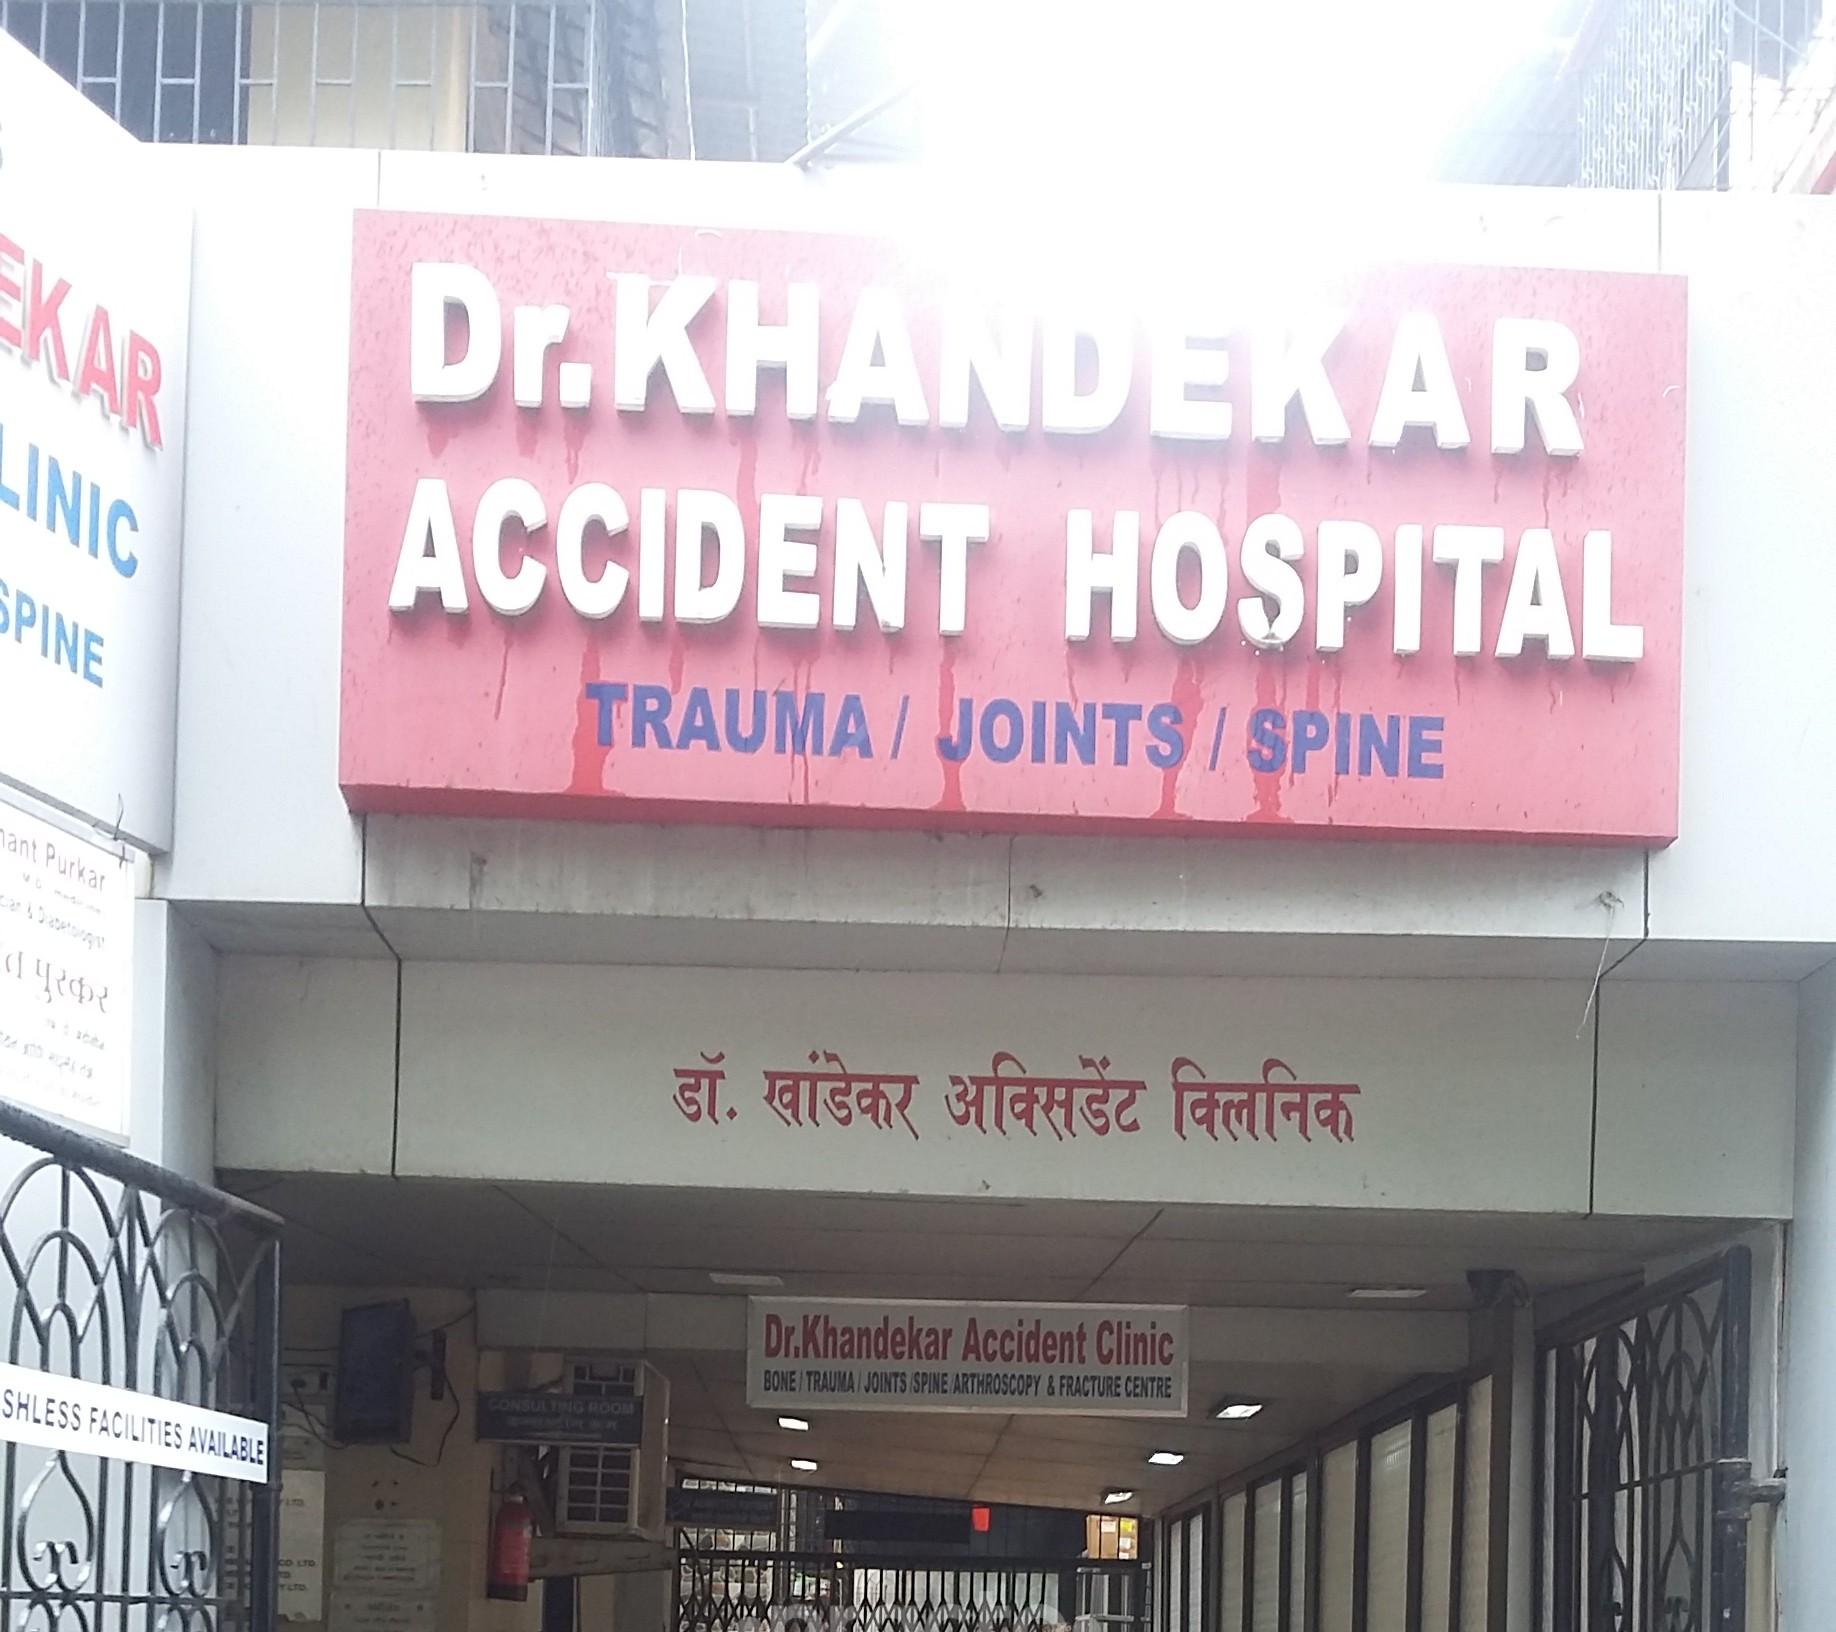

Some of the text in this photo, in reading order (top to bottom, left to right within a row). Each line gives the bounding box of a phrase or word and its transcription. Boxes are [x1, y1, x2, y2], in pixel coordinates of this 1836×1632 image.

[389, 477, 1644, 663] ACCIDENT HOSPITAL
[586, 682, 873, 760] TRAUMA
[937, 697, 1185, 770] JOINTS
[1247, 709, 1445, 779] SPINE
[46, 842, 105, 892] Purkar
[673, 1050, 738, 1125] डॉ.
[762, 1049, 920, 1140] खांडेकर
[1171, 1057, 1361, 1143] क्लिनिक
[961, 1317, 1087, 1364] Accident
[1096, 1319, 1174, 1366] Clinic
[487, 1399, 634, 1415] CONSULTING ROOM
[763, 1369, 797, 1392] BONE
[806, 1370, 855, 1393] TRAUMA
[864, 1371, 907, 1394] JOINTS
[1046, 1375, 1055, 1397] &
[1059, 1375, 1121, 1398] FRACTURE
[1125, 1376, 1172, 1399] CENTRE
[2, 1389, 264, 1465] SHLESS FACILITIES AVAILABLE
